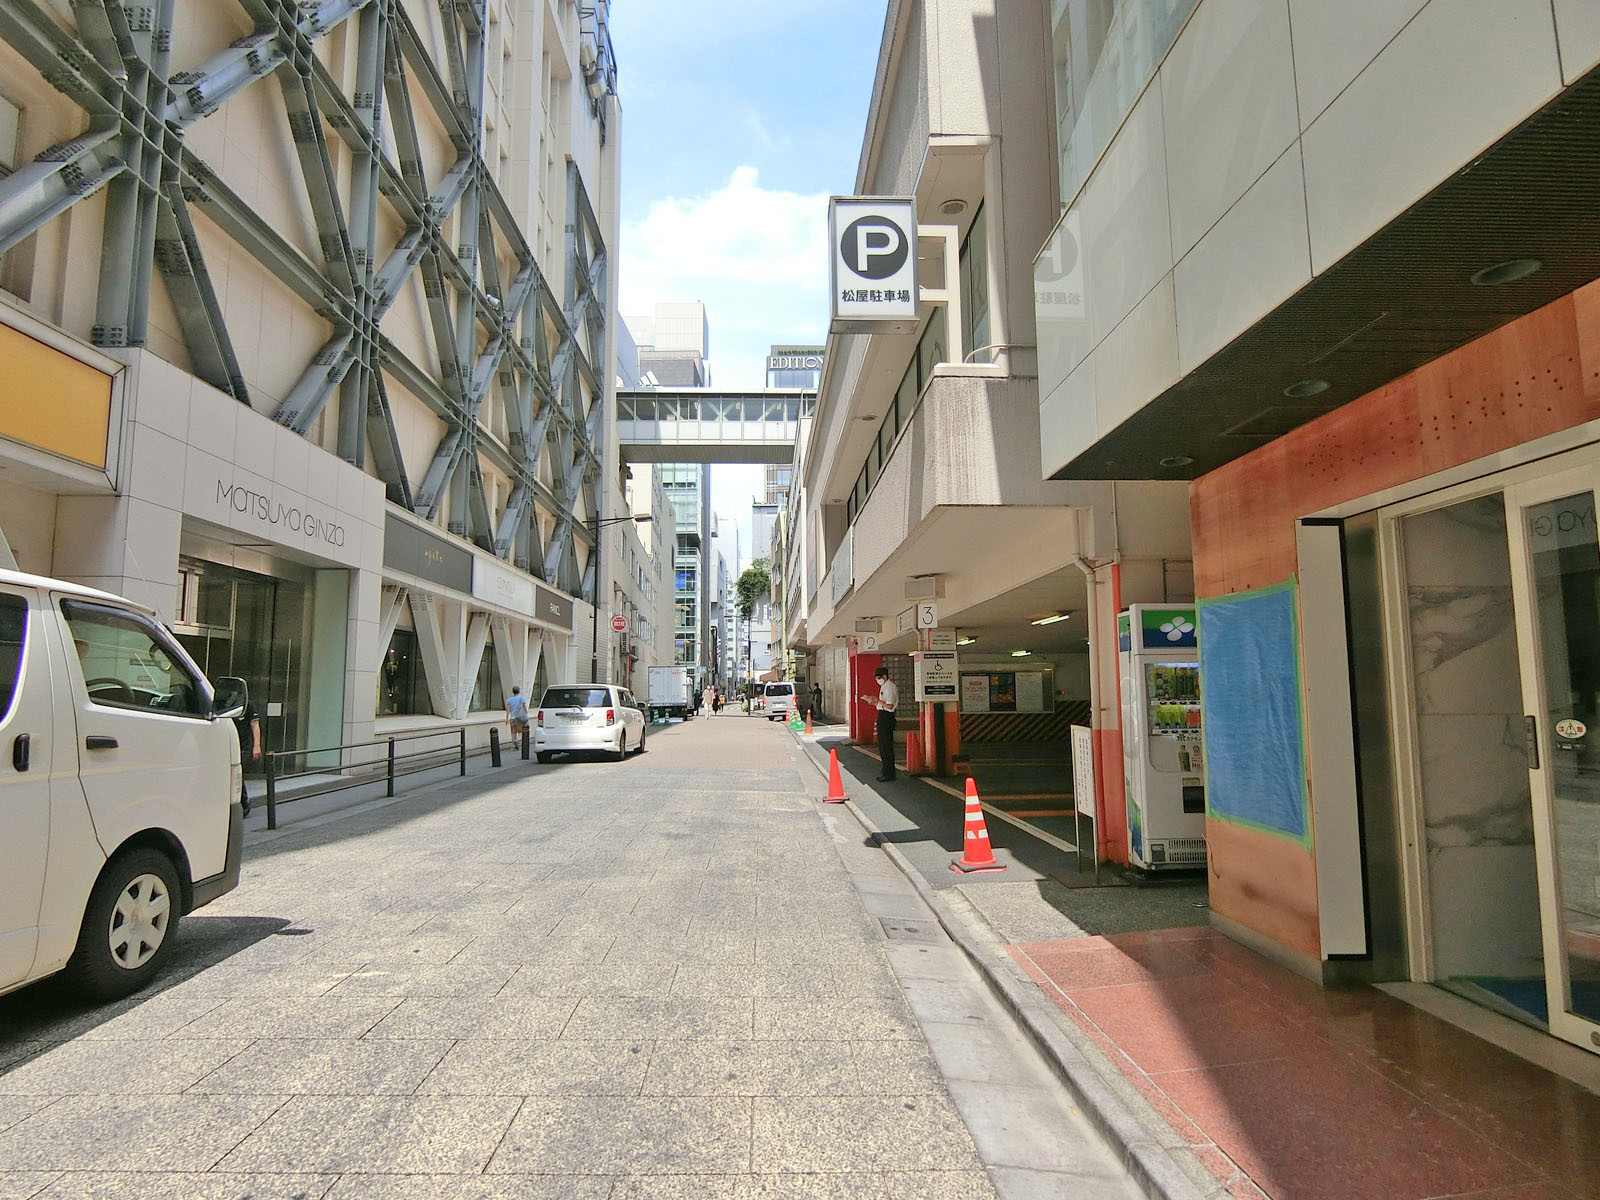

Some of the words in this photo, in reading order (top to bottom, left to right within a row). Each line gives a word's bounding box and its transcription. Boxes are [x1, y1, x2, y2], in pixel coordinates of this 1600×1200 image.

[856, 224, 900, 272] P
[841, 289, 911, 303] 松屋駐車場
[922, 606, 934, 625] 3
[866, 636, 876, 650] 2
